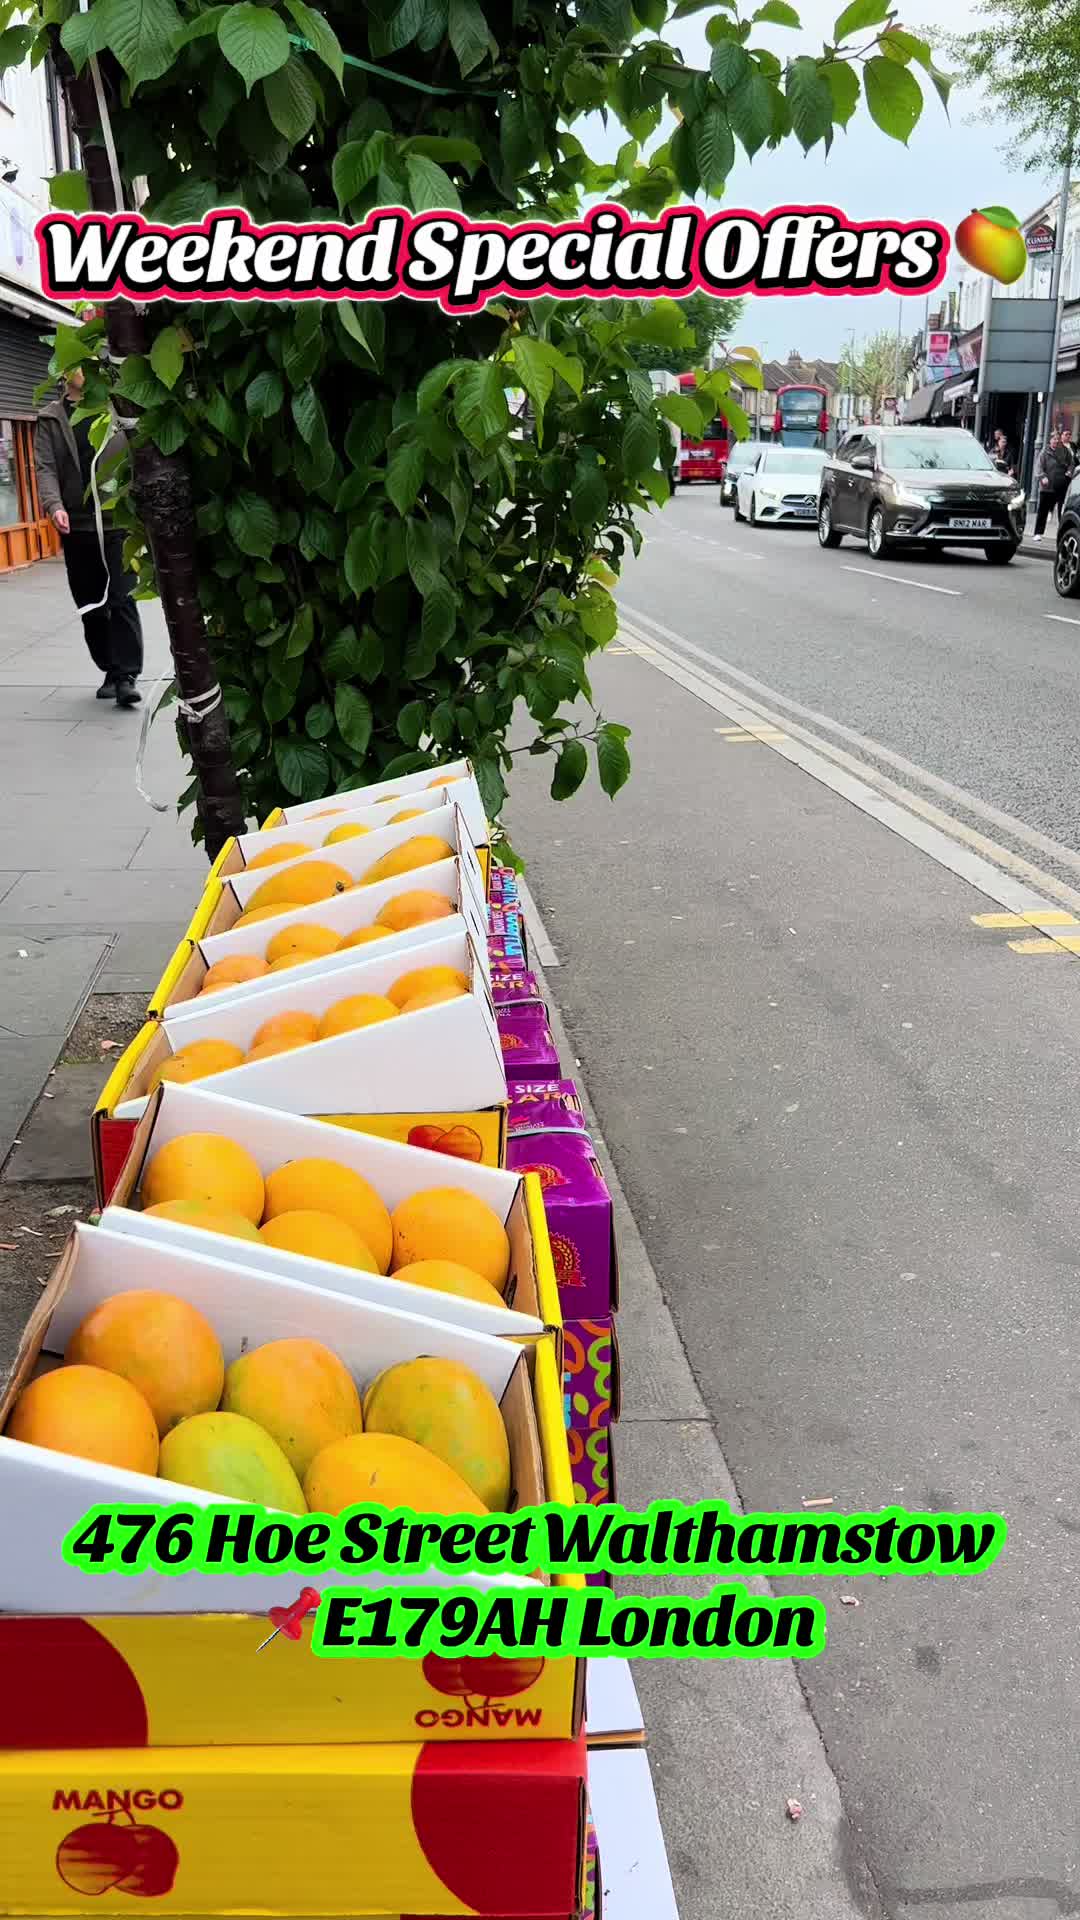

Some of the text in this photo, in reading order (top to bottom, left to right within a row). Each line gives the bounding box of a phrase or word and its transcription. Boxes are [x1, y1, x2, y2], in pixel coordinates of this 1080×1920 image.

[514, 1083, 560, 1094] SIZE
[415, 1708, 542, 1727] MANGO
[52, 1789, 184, 1810] MANGO
